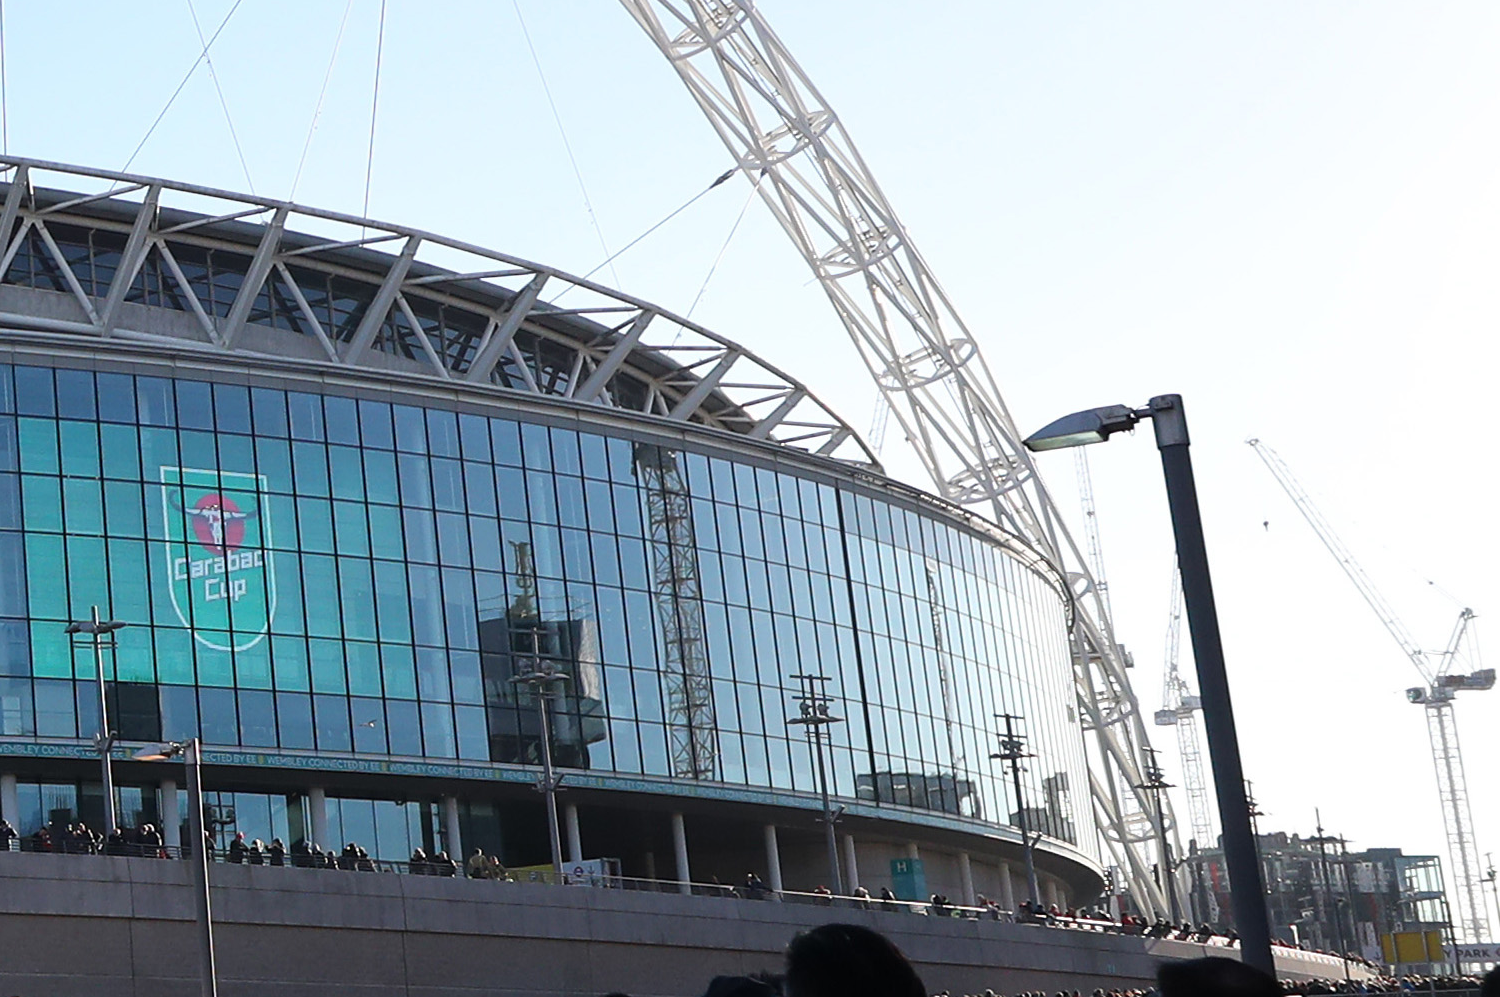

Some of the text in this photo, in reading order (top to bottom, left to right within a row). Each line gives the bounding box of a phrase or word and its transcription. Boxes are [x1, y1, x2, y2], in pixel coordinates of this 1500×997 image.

[174, 549, 268, 581] Carabao
[205, 578, 247, 602] Cup
[897, 861, 907, 872] H
[1456, 949, 1490, 959] PARK
